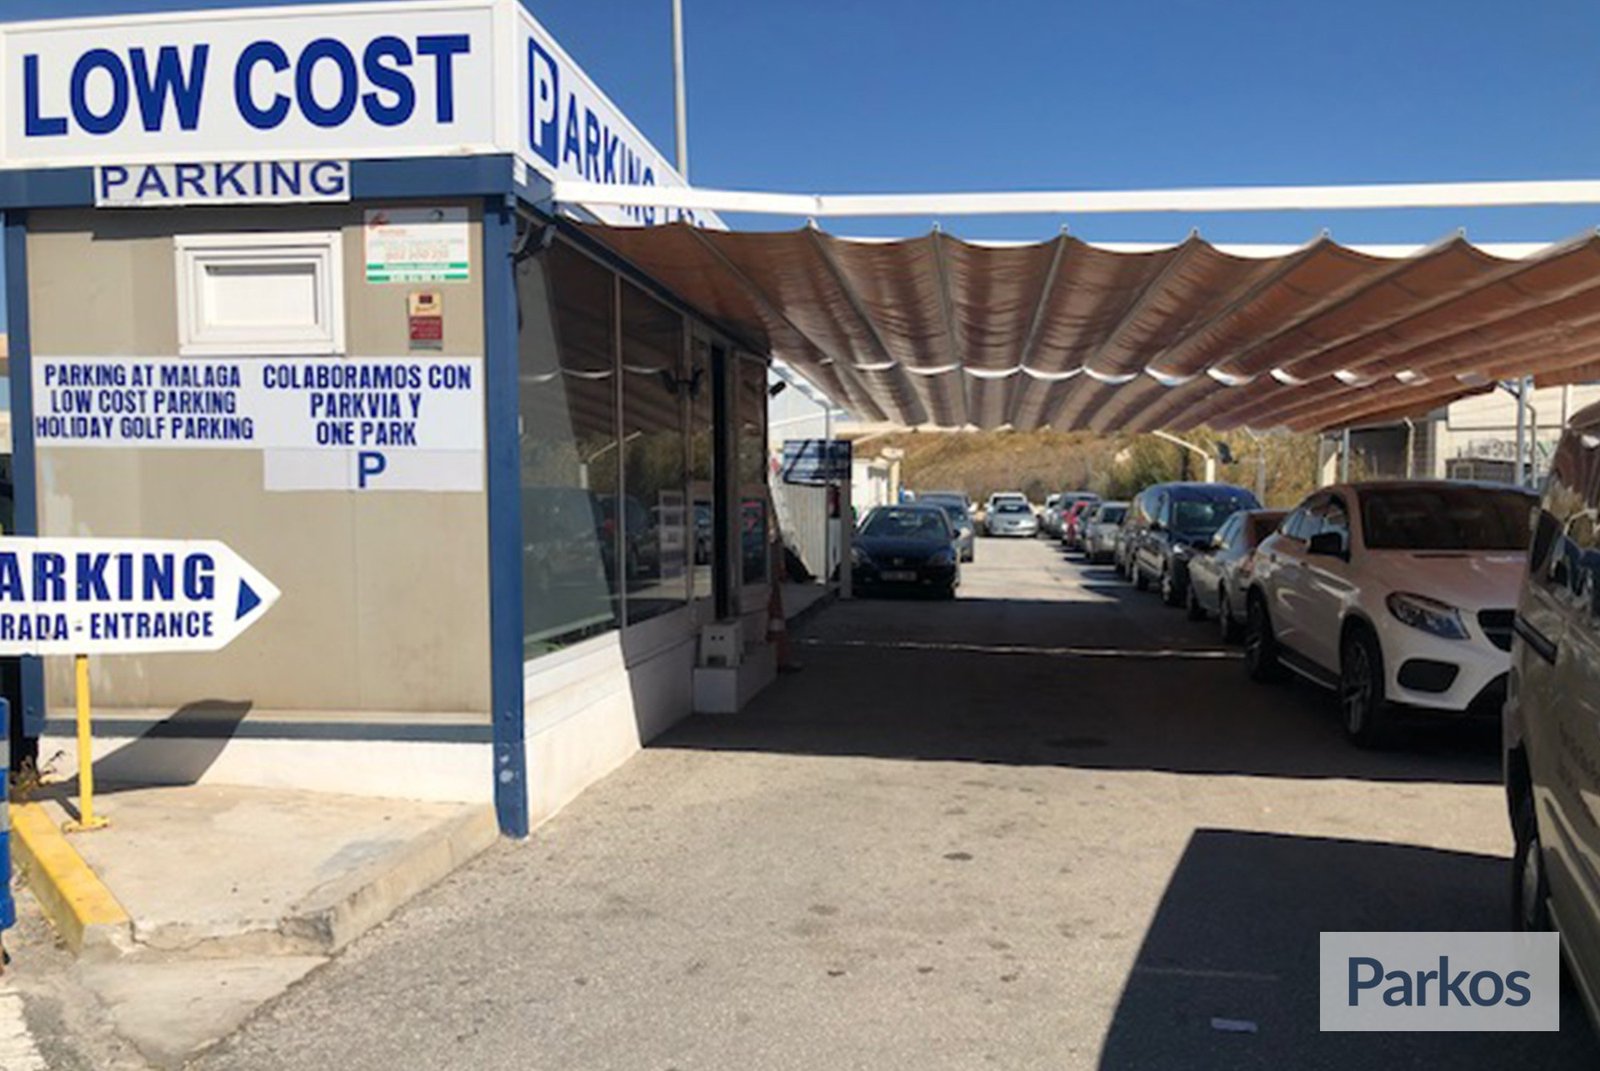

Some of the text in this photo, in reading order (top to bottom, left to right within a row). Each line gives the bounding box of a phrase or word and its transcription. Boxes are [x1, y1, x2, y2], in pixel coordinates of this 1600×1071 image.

[24, 34, 470, 137] LOW COST
[102, 161, 345, 198] PARKING
[45, 364, 240, 387] PARKING AT MALAGA
[263, 365, 471, 389] COLABORAMOS CON
[52, 390, 235, 414] LOW COST PARKING
[311, 393, 421, 418] PARKVIA Y
[36, 416, 253, 439] HOLIDAY GOLF PARKING
[317, 421, 415, 445] ONE PARK
[358, 451, 386, 487] P
[91, 612, 211, 639] ENTRANCE
